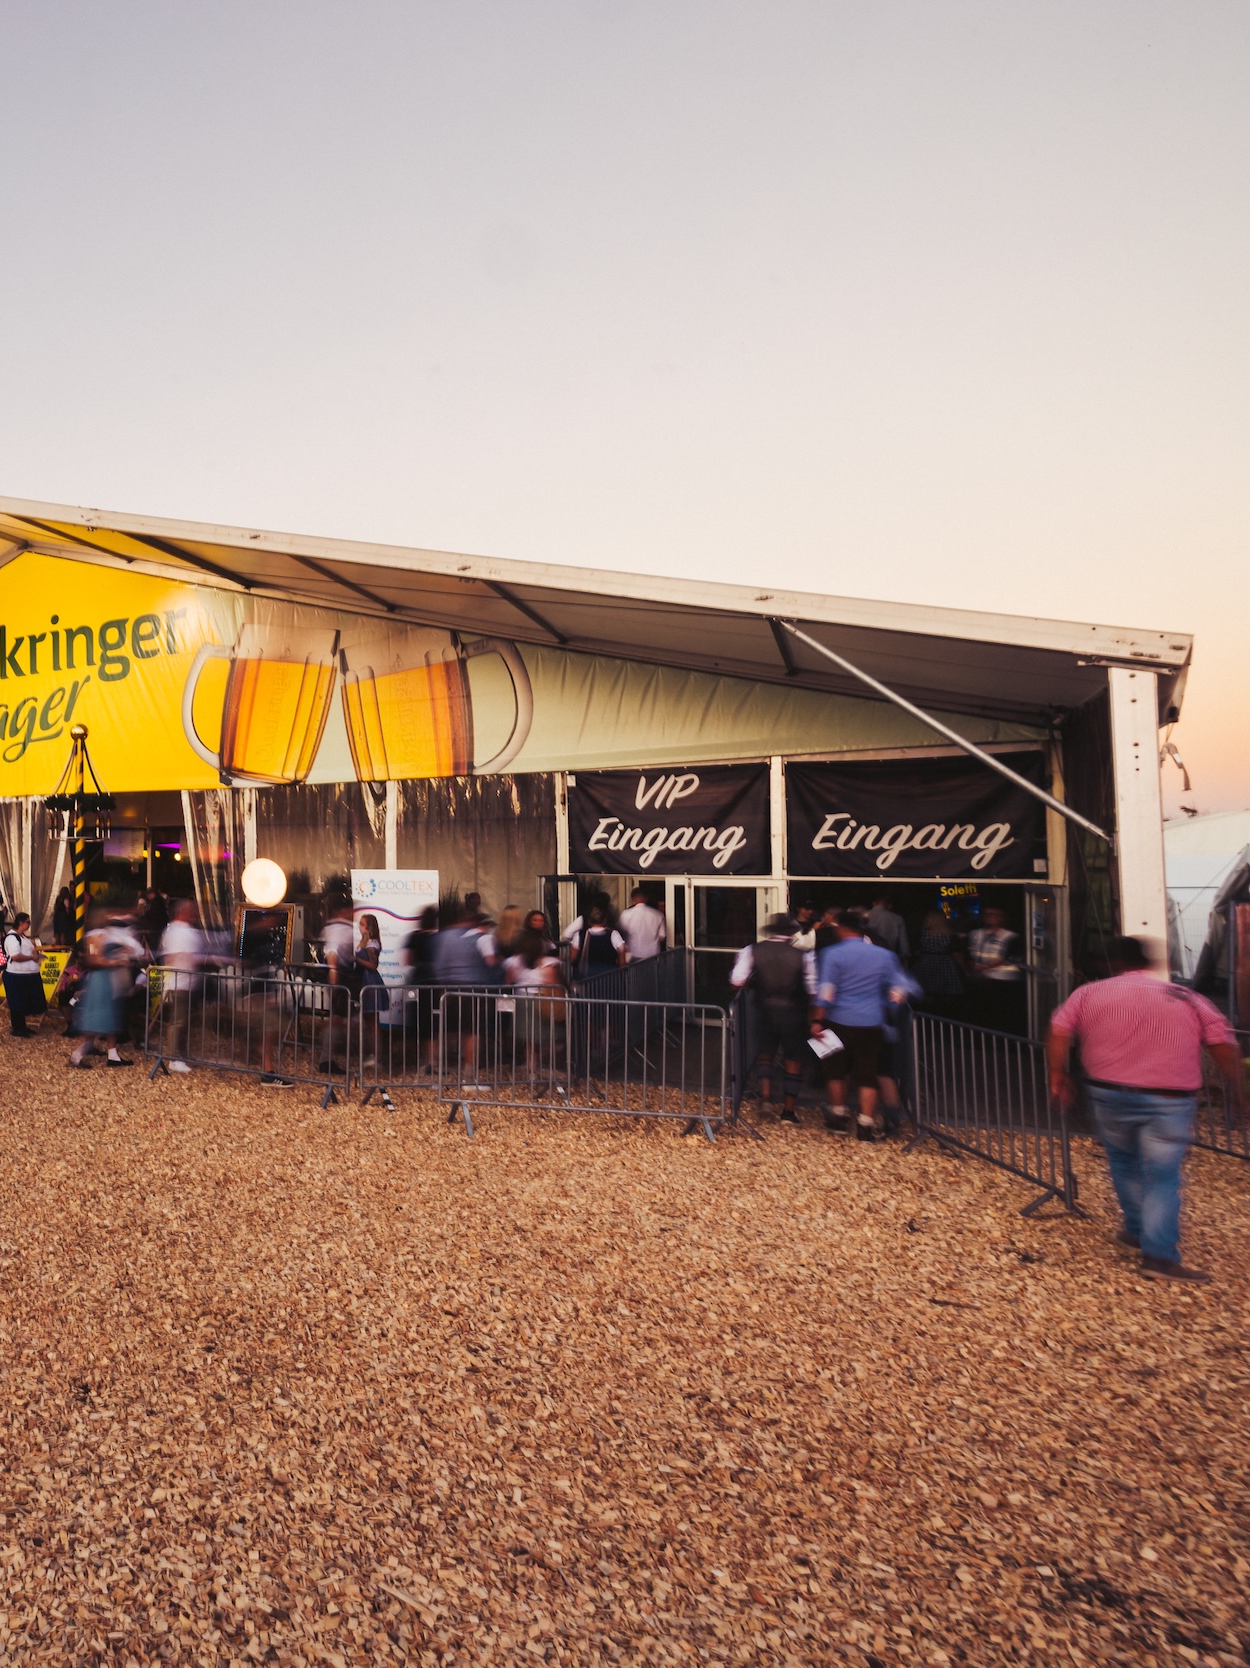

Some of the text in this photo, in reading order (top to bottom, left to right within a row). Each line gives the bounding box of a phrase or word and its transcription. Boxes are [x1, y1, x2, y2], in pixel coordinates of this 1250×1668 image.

[635, 774, 699, 810] VIP
[588, 817, 746, 869] Eingang
[812, 813, 1014, 870] Eingang
[378, 880, 433, 891] COOLTEX
[940, 883, 977, 897] Soletti
